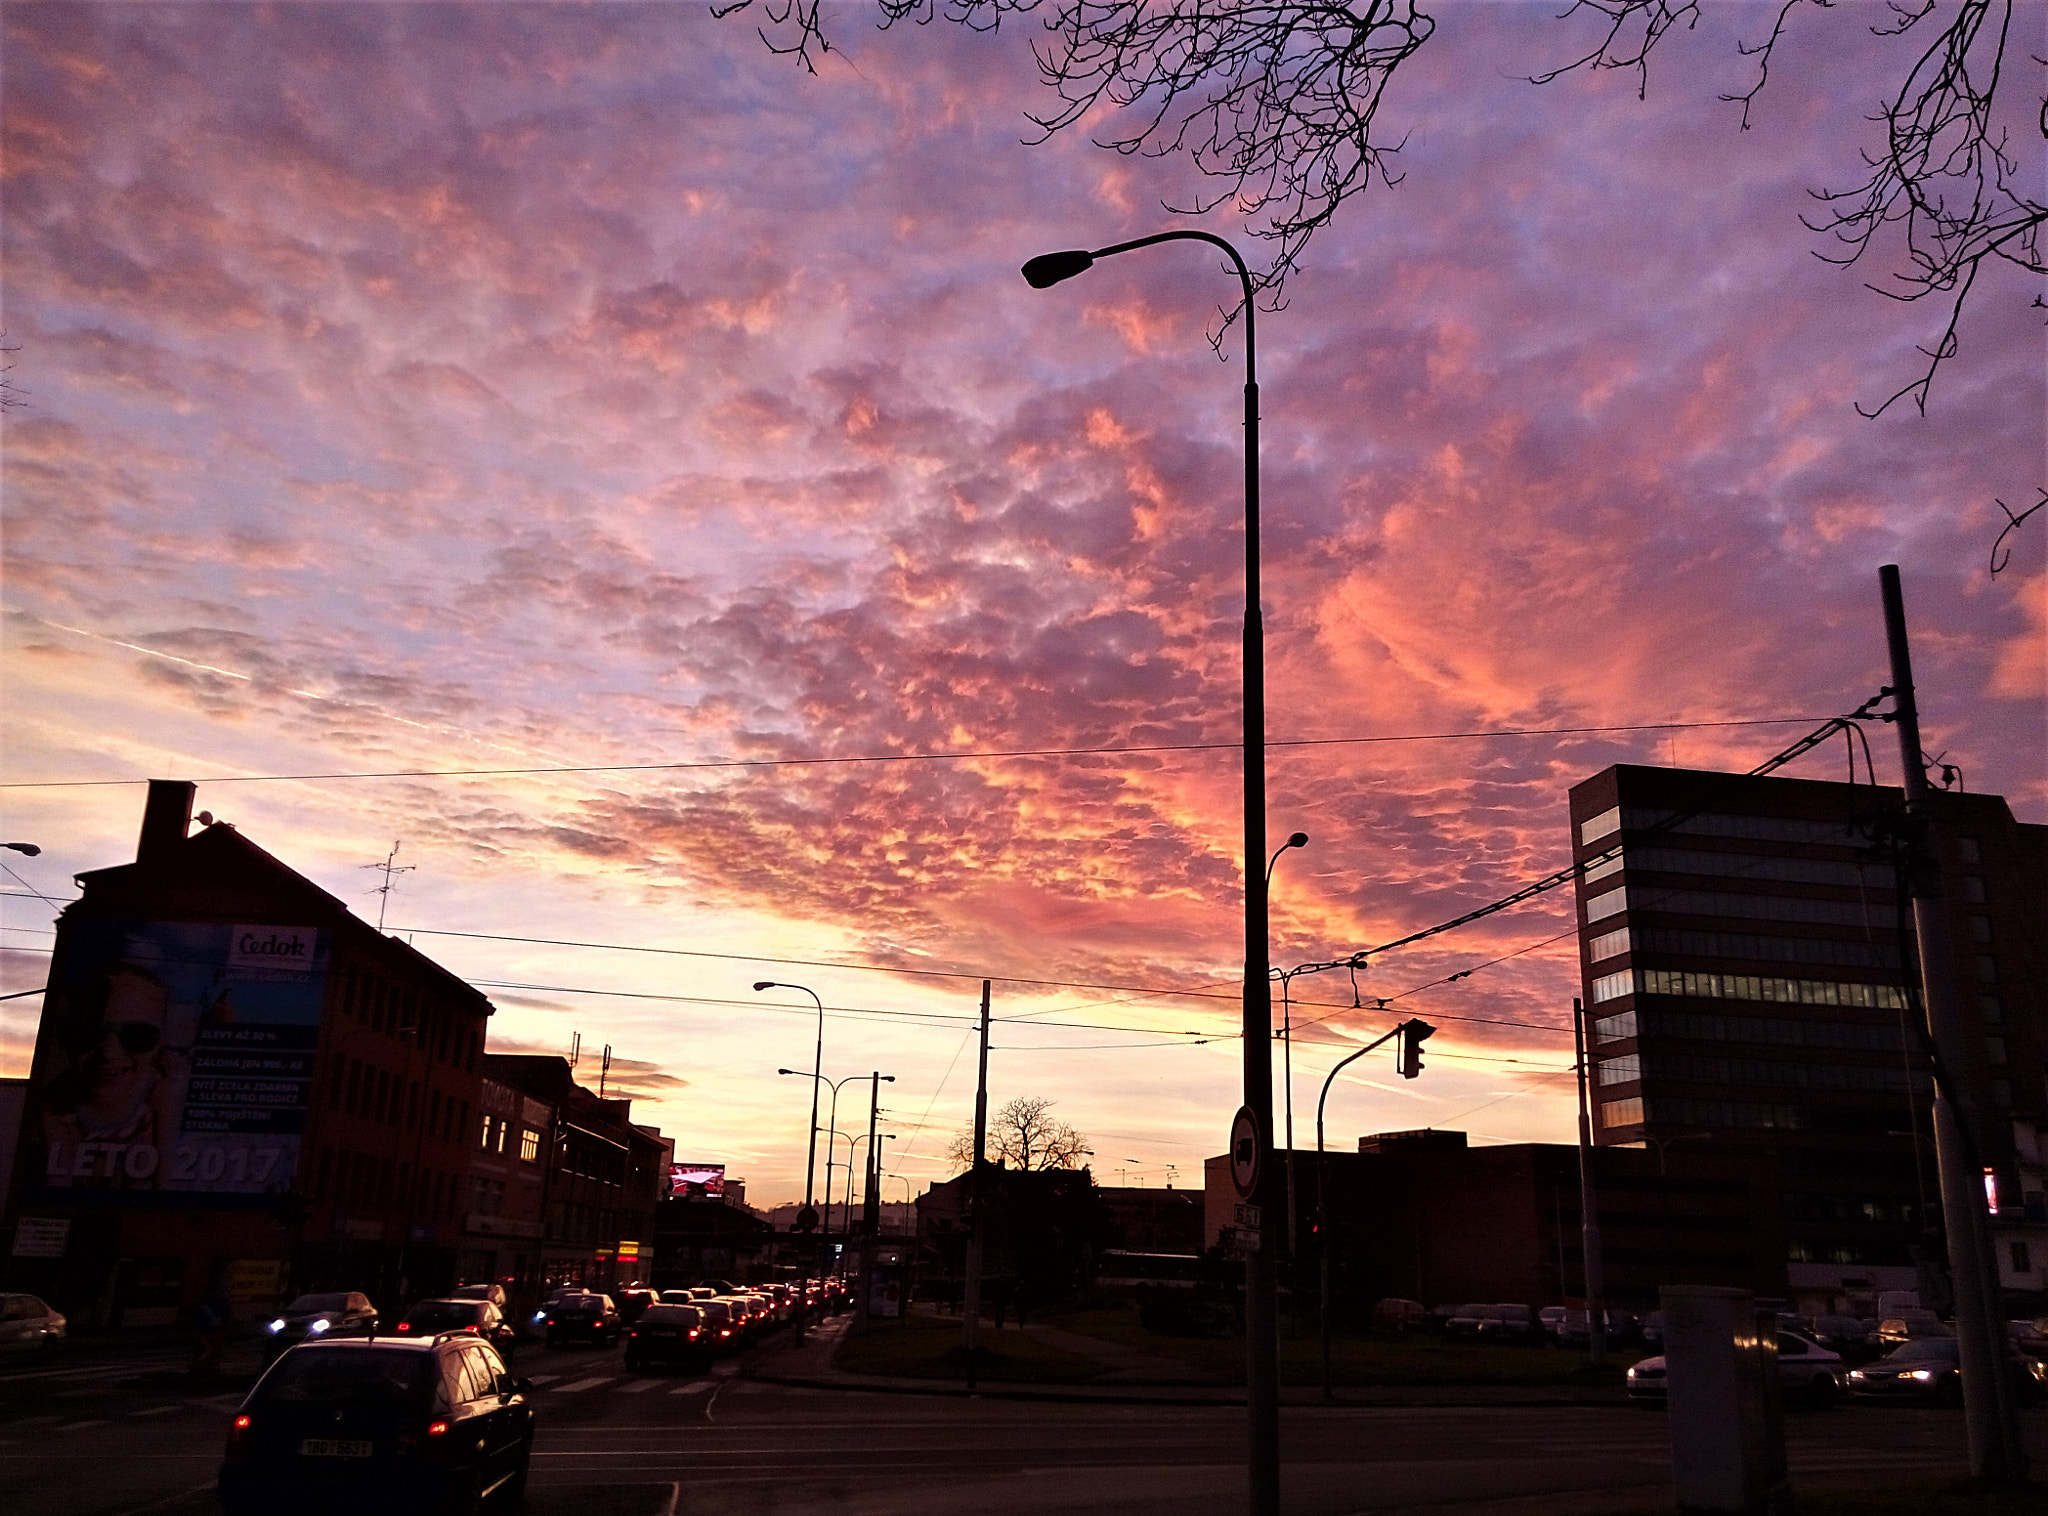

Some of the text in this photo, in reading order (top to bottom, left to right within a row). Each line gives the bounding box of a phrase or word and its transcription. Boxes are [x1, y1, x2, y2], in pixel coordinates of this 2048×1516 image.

[200, 1029, 232, 1040] SLEVY
[217, 1081, 250, 1092] ZCELA
[252, 1082, 299, 1093] ZDARMA
[199, 1092, 232, 1102] SLEVA
[234, 1093, 256, 1103] PRO
[185, 1120, 229, 1131] STORNA
[171, 1145, 282, 1181] 2017
